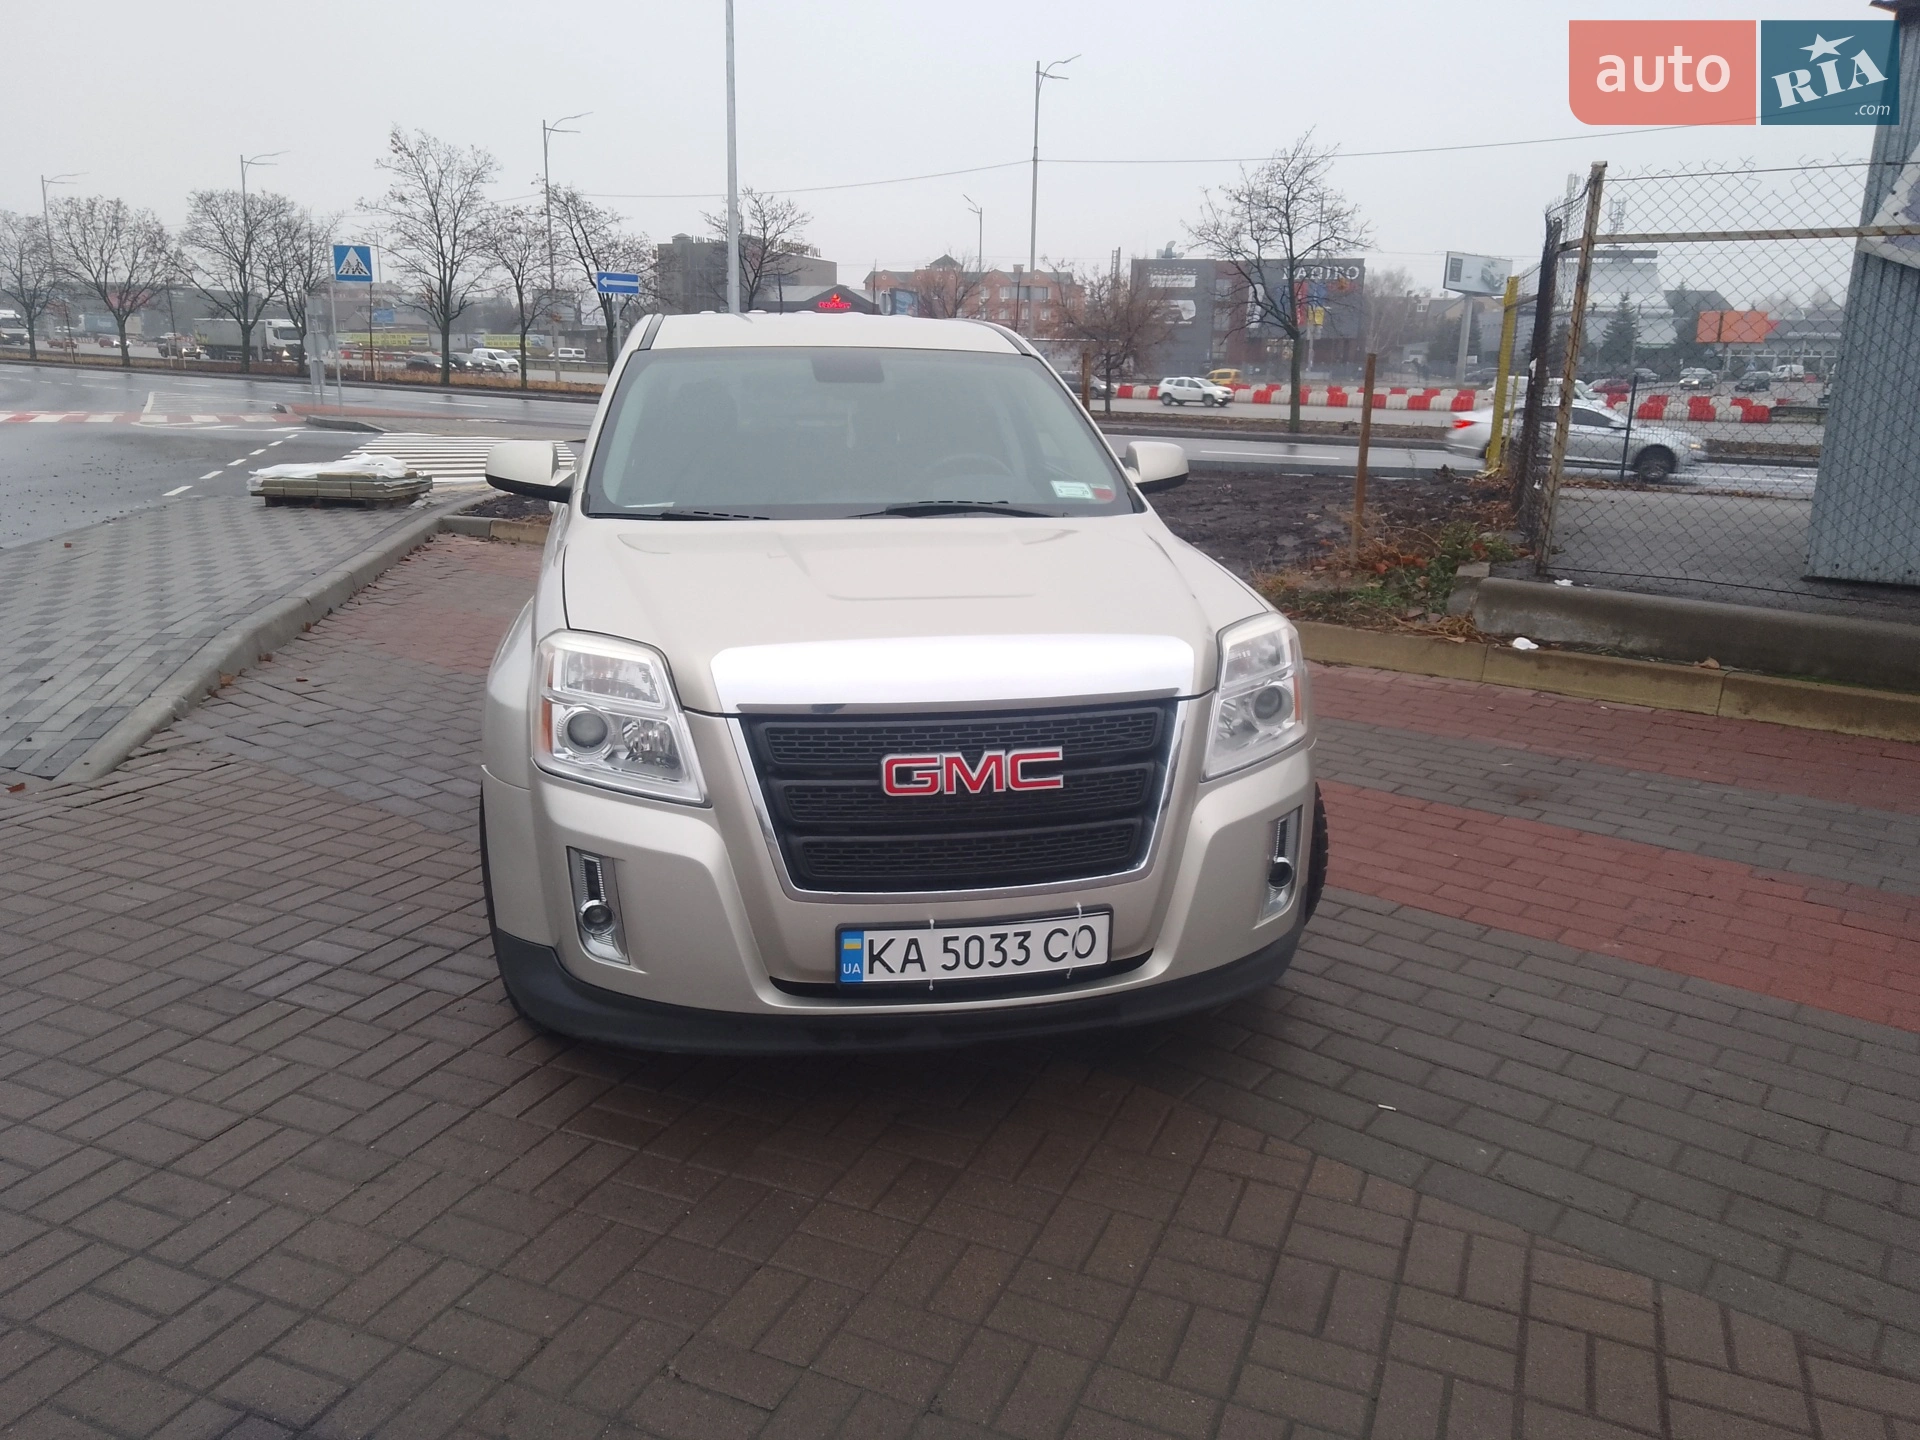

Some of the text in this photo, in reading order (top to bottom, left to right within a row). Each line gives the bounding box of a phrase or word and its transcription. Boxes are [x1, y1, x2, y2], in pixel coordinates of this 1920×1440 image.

[881, 745, 1064, 797] GMC
[842, 924, 1097, 975] UA KA 5033 CO
